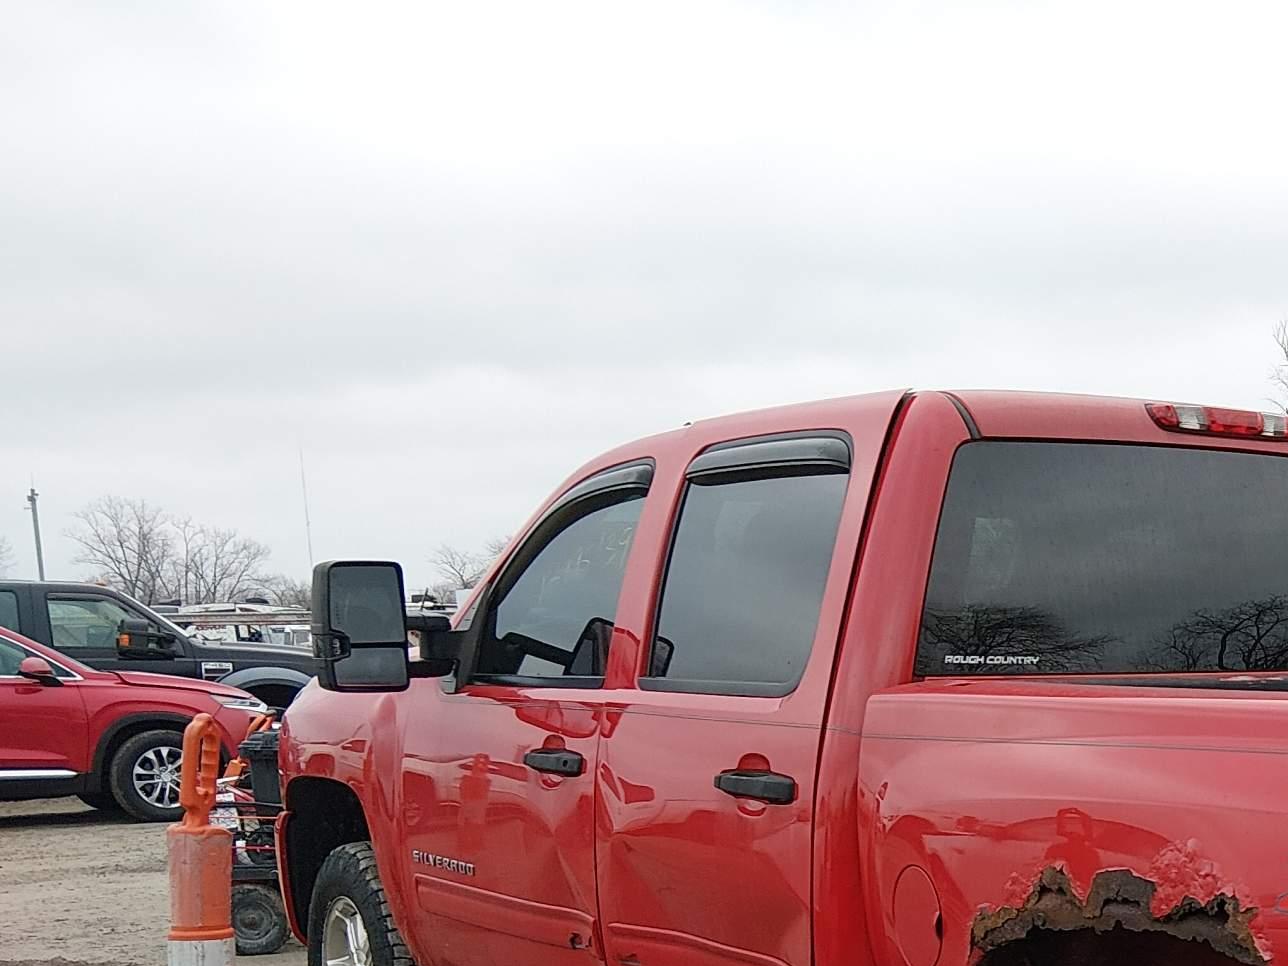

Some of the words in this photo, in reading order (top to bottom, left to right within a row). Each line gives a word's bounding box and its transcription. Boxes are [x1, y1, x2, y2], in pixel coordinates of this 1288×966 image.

[944, 655, 985, 664] ROUGH
[986, 655, 1040, 665] COUNTRY
[412, 850, 475, 876] SILVERADO
